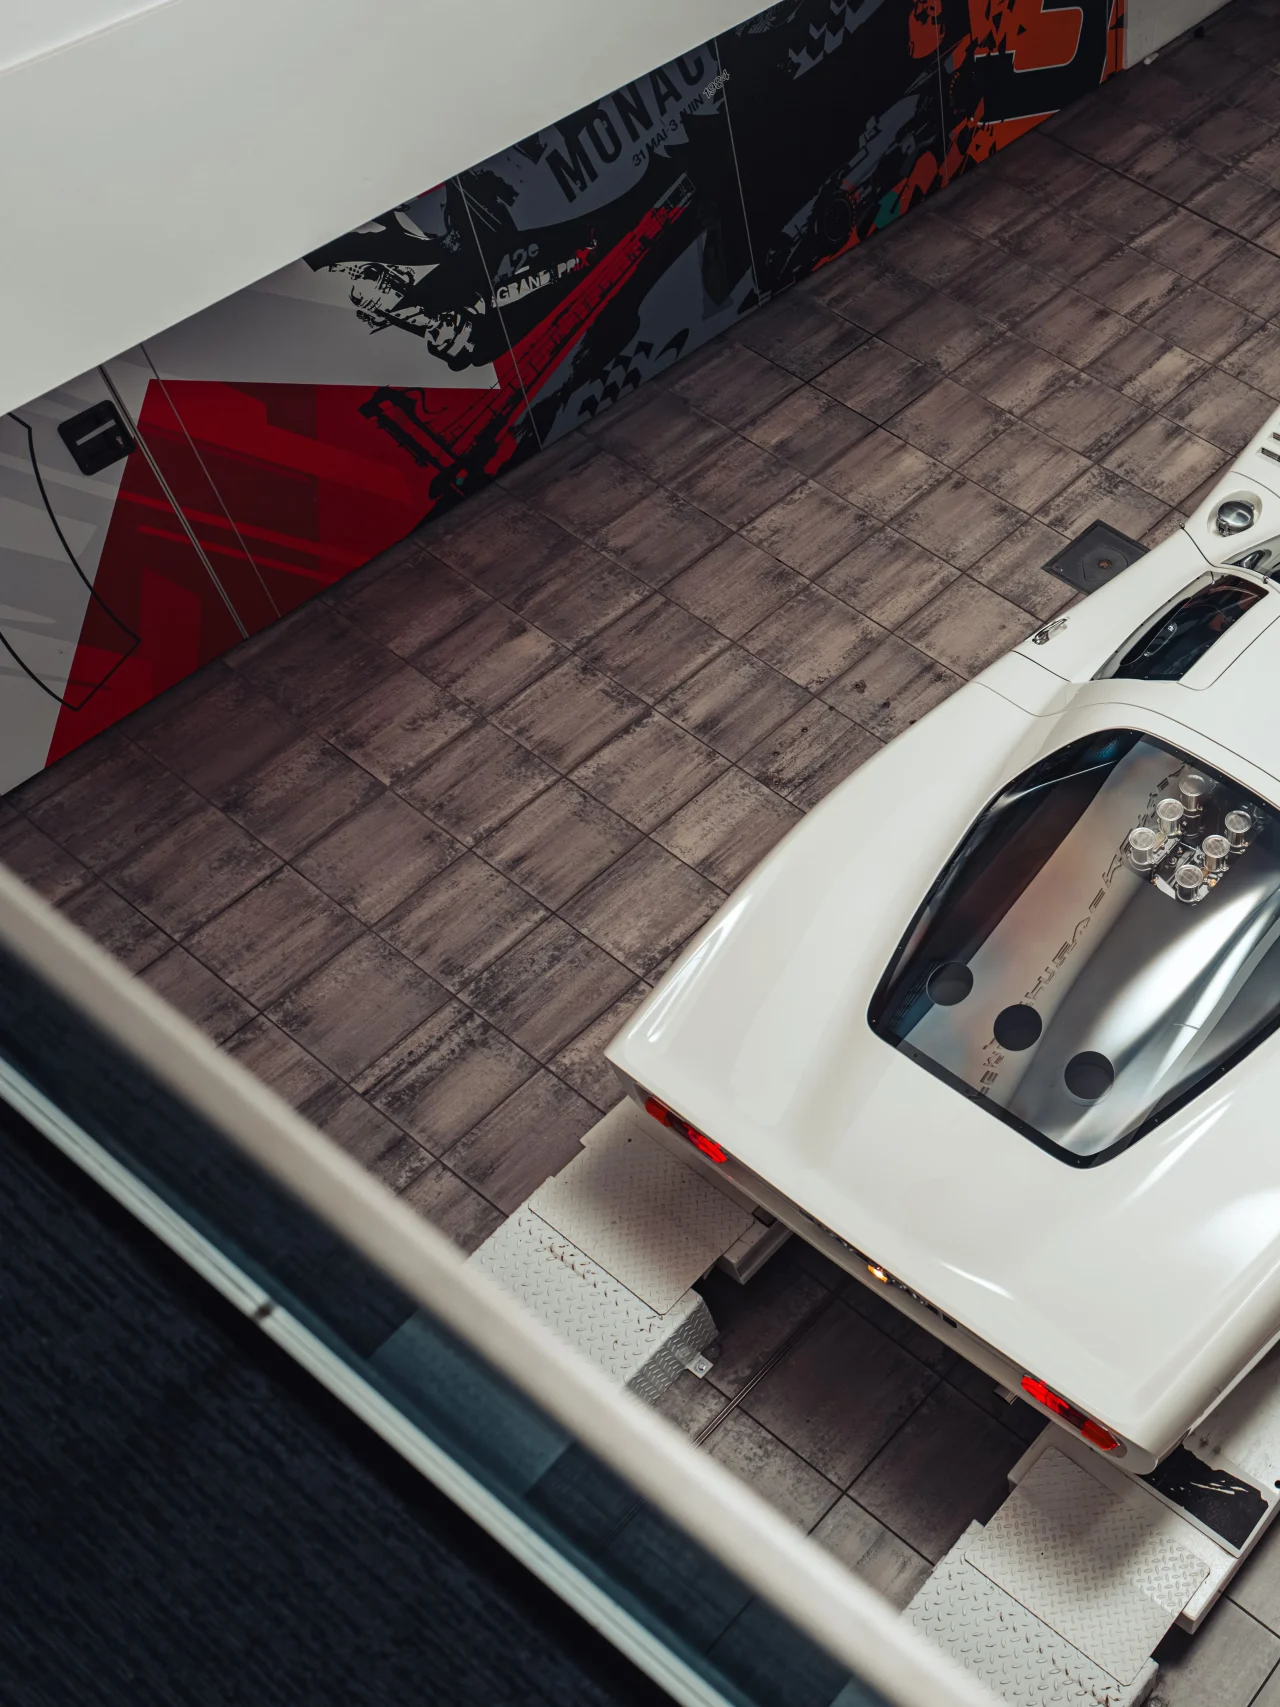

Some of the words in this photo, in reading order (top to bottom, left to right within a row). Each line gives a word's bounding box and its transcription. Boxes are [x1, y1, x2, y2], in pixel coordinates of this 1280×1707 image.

[545, 34, 719, 203] MONAC
[632, 148, 648, 166] 31
[702, 68, 730, 98] 1984
[494, 243, 539, 282] 42e
[496, 269, 551, 303] GRAND
[557, 246, 593, 279] PRIX
